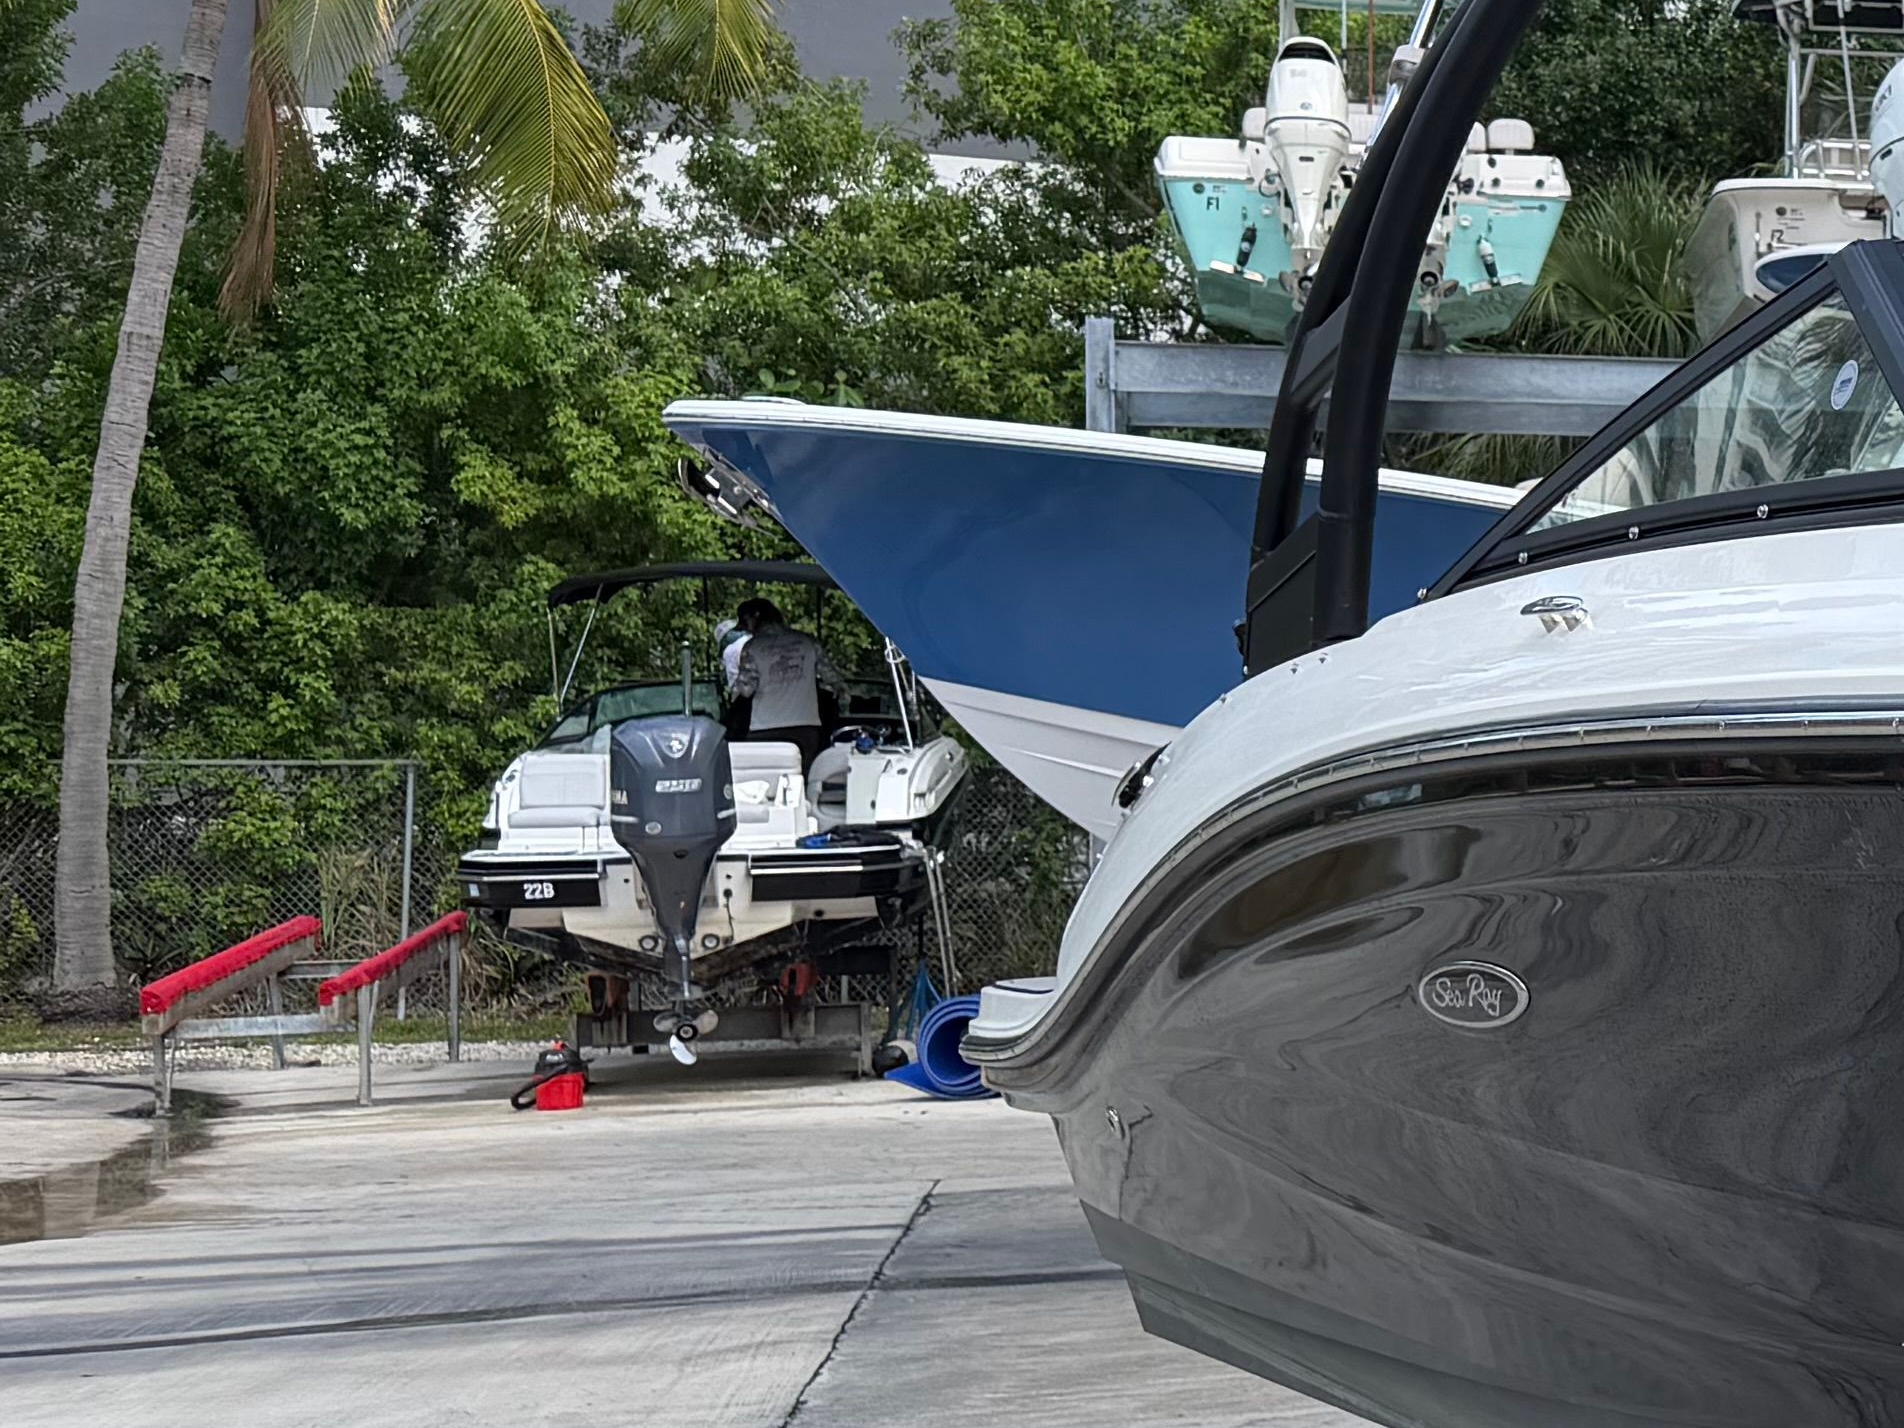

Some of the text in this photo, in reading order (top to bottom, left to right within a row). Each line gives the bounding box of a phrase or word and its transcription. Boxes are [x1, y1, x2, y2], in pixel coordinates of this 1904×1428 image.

[523, 882, 555, 900] 22B
[1431, 972, 1503, 1017] Sea Ray
